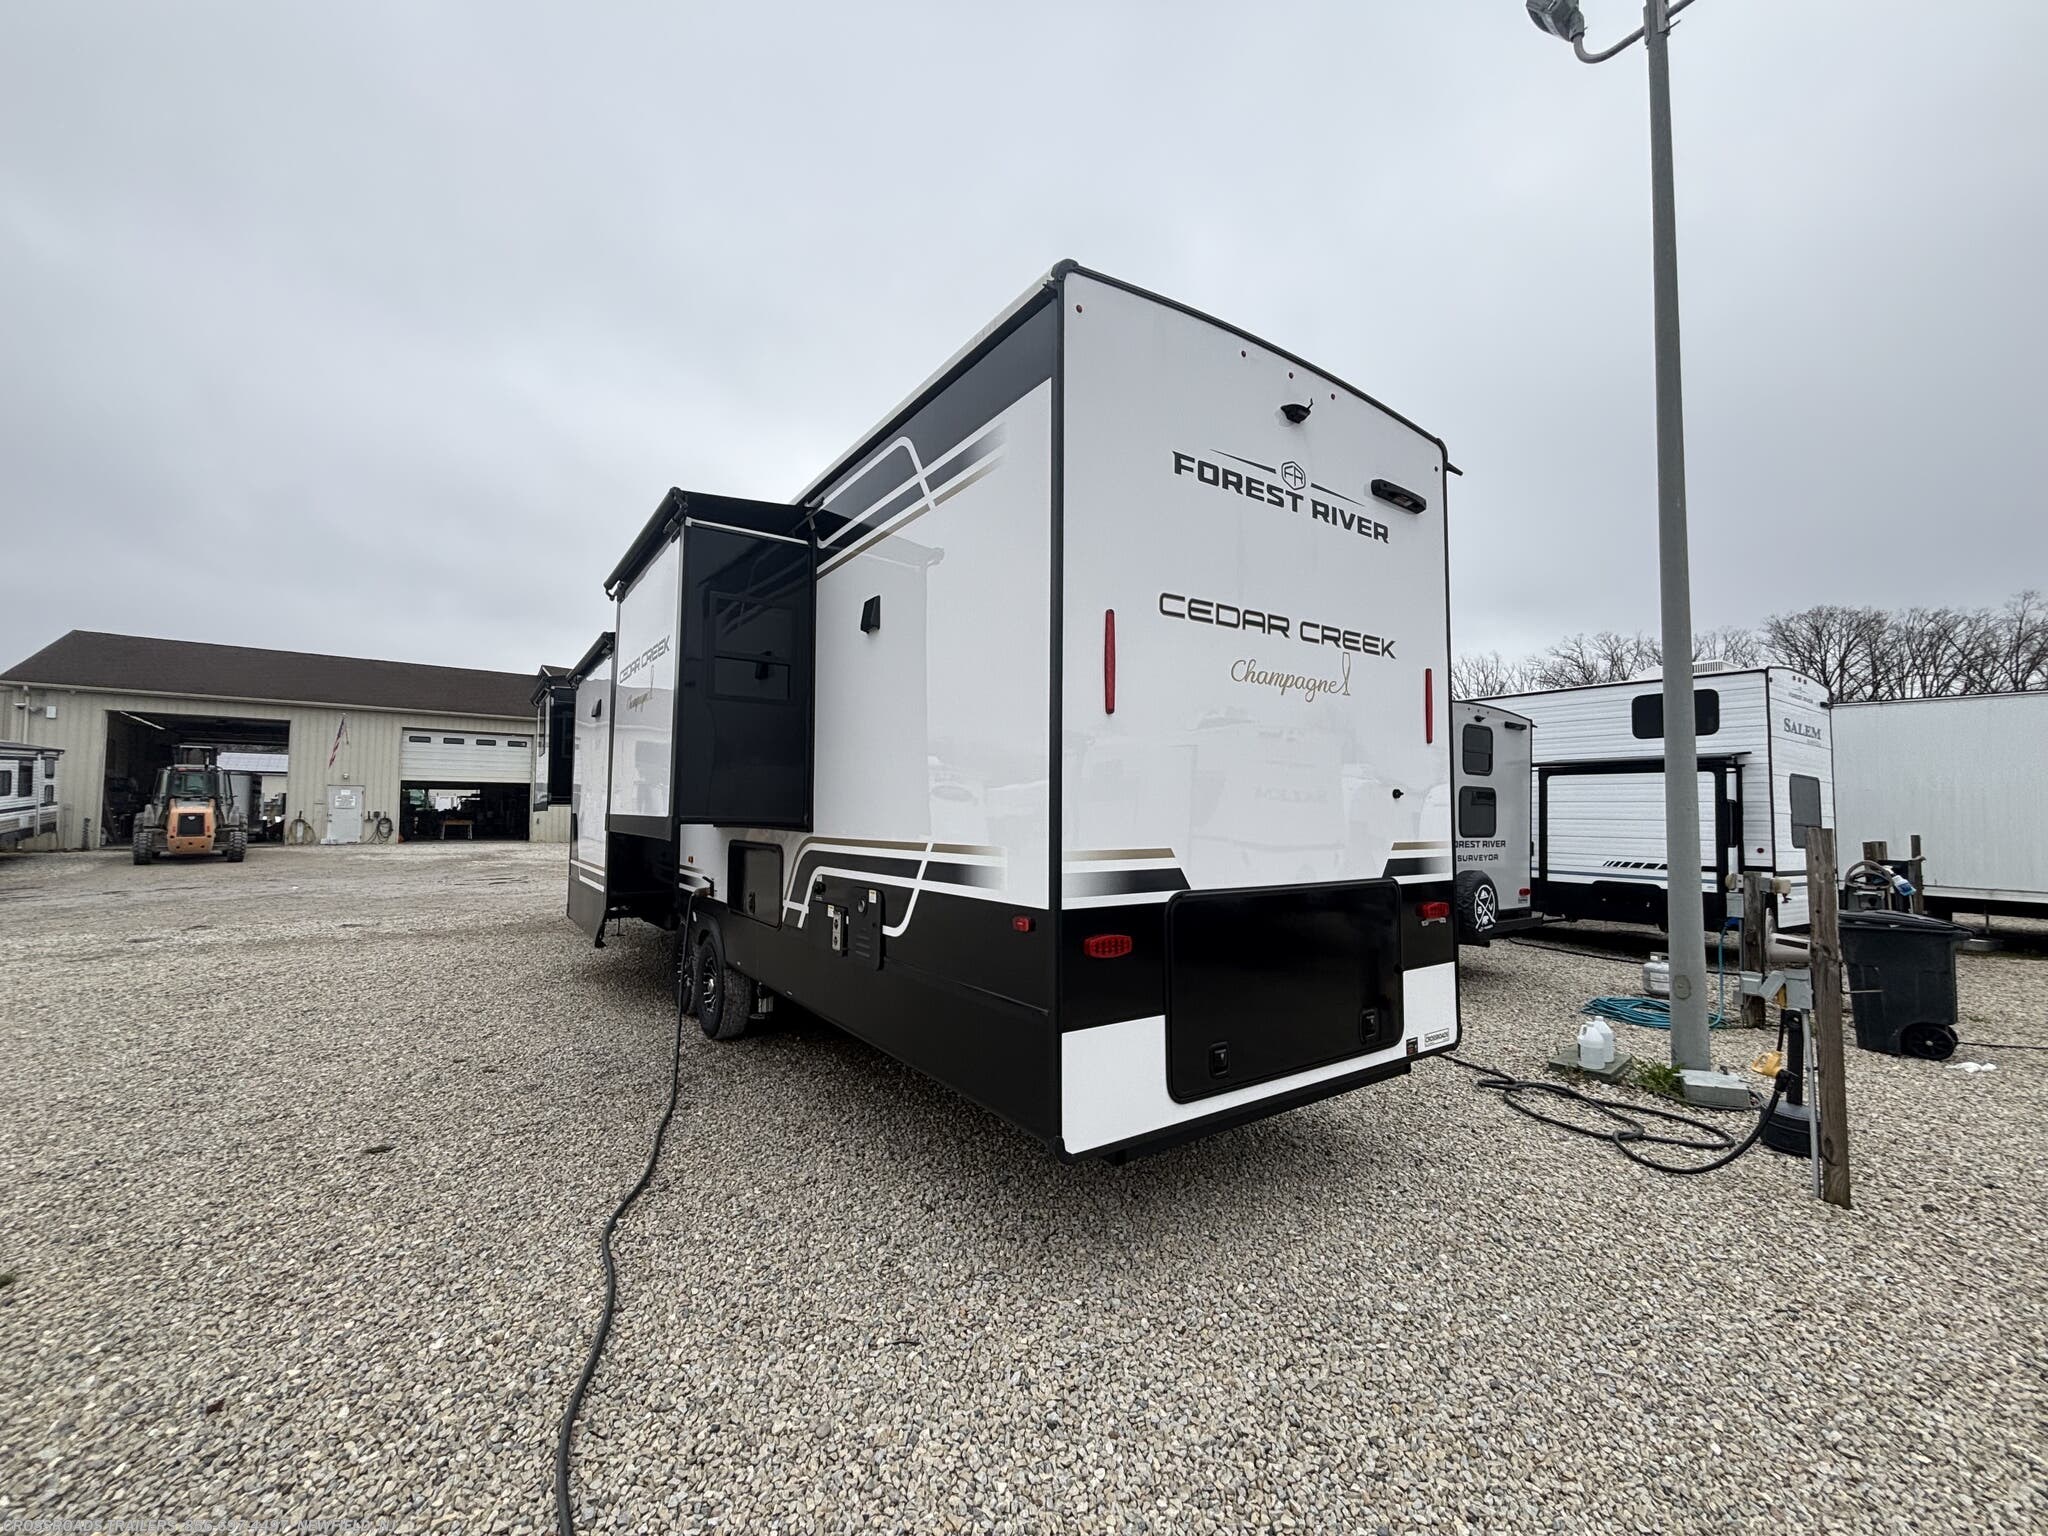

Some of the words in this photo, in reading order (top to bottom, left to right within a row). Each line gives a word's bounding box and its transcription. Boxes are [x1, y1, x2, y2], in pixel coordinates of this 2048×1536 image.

[1172, 450, 1304, 513] FOREST
[1311, 498, 1389, 544] RIVER
[1159, 592, 1290, 639] CEDAR
[1300, 621, 1396, 660] CREEK
[641, 635, 670, 668] CREEK
[1230, 658, 1351, 703] Champagne
[1783, 717, 1822, 740] SALEM
[1457, 854, 1499, 862] SURVEYOR
[1482, 840, 1506, 848] RIVER
